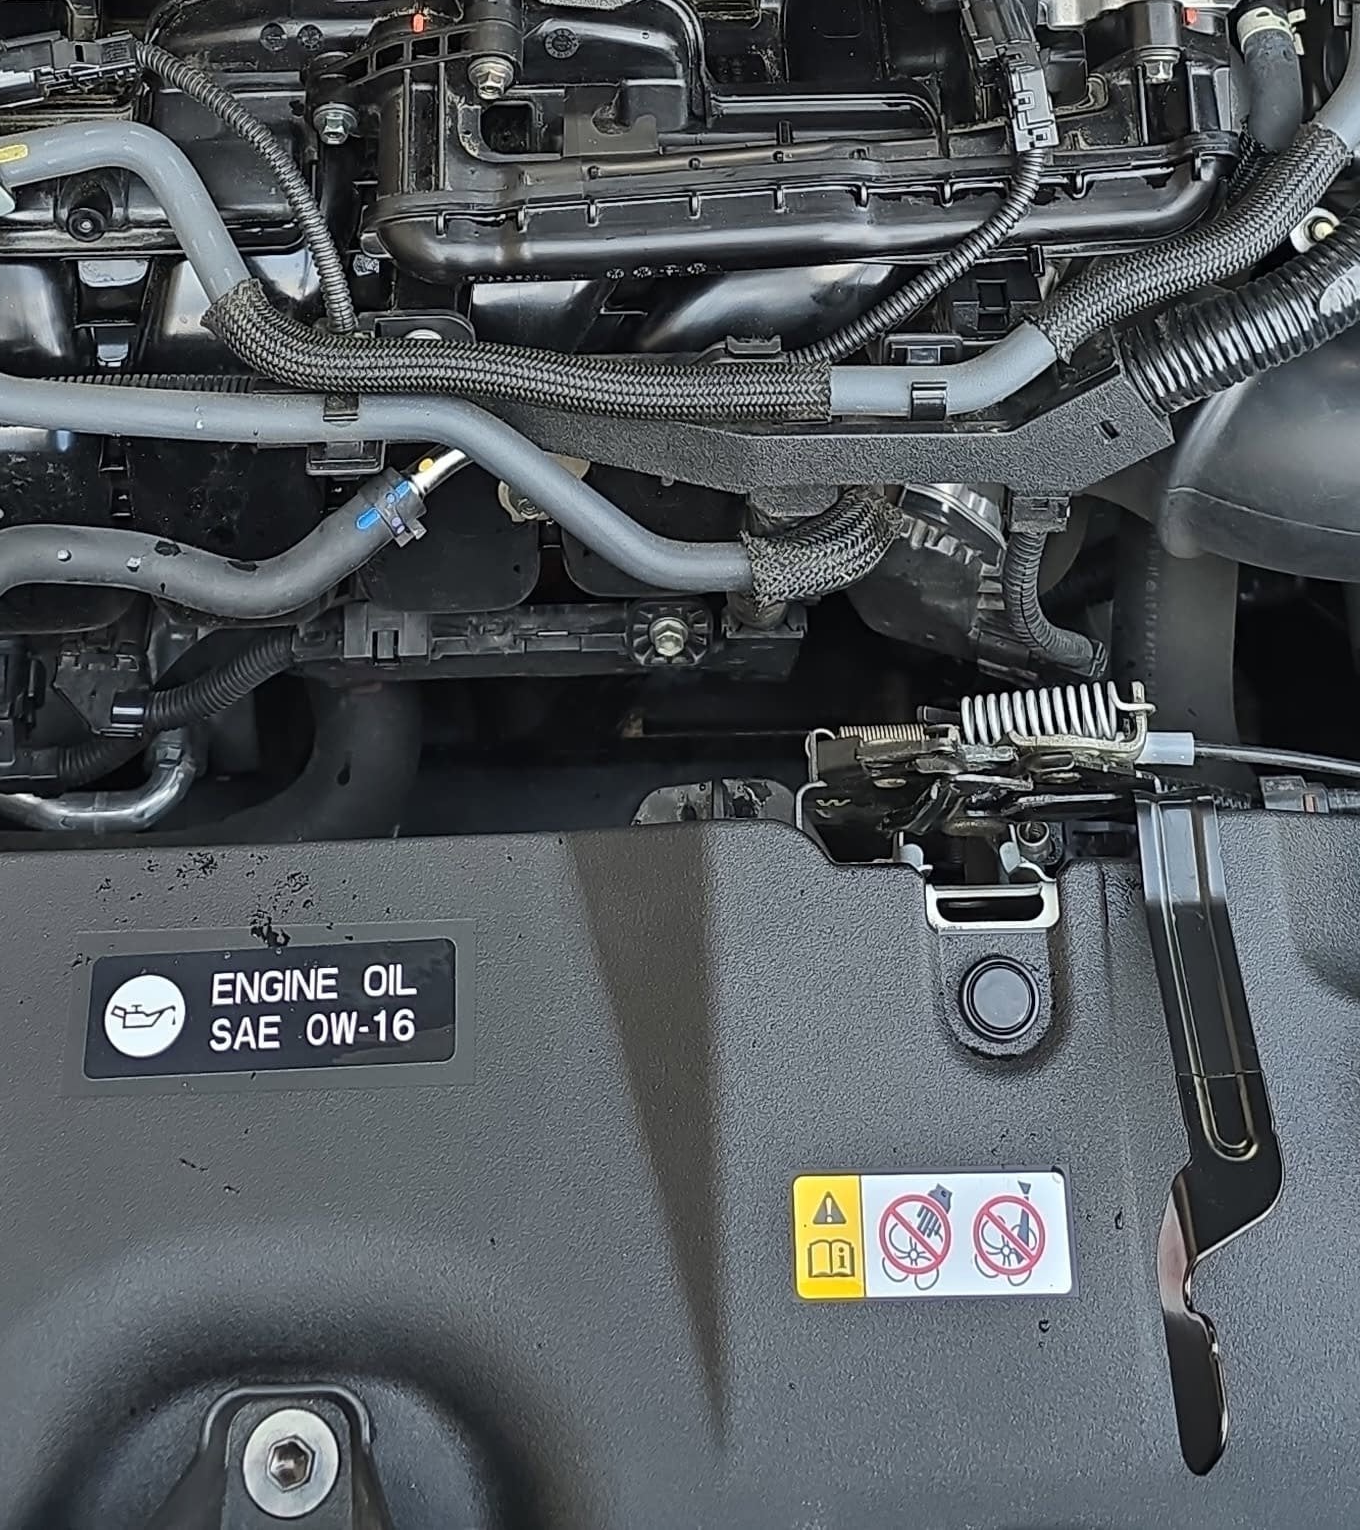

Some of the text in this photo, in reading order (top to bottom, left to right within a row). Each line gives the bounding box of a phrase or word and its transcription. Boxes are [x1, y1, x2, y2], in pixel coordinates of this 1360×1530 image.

[211, 962, 418, 1007] ENGINE OIL
[209, 1009, 416, 1053] SAE 0W-16
